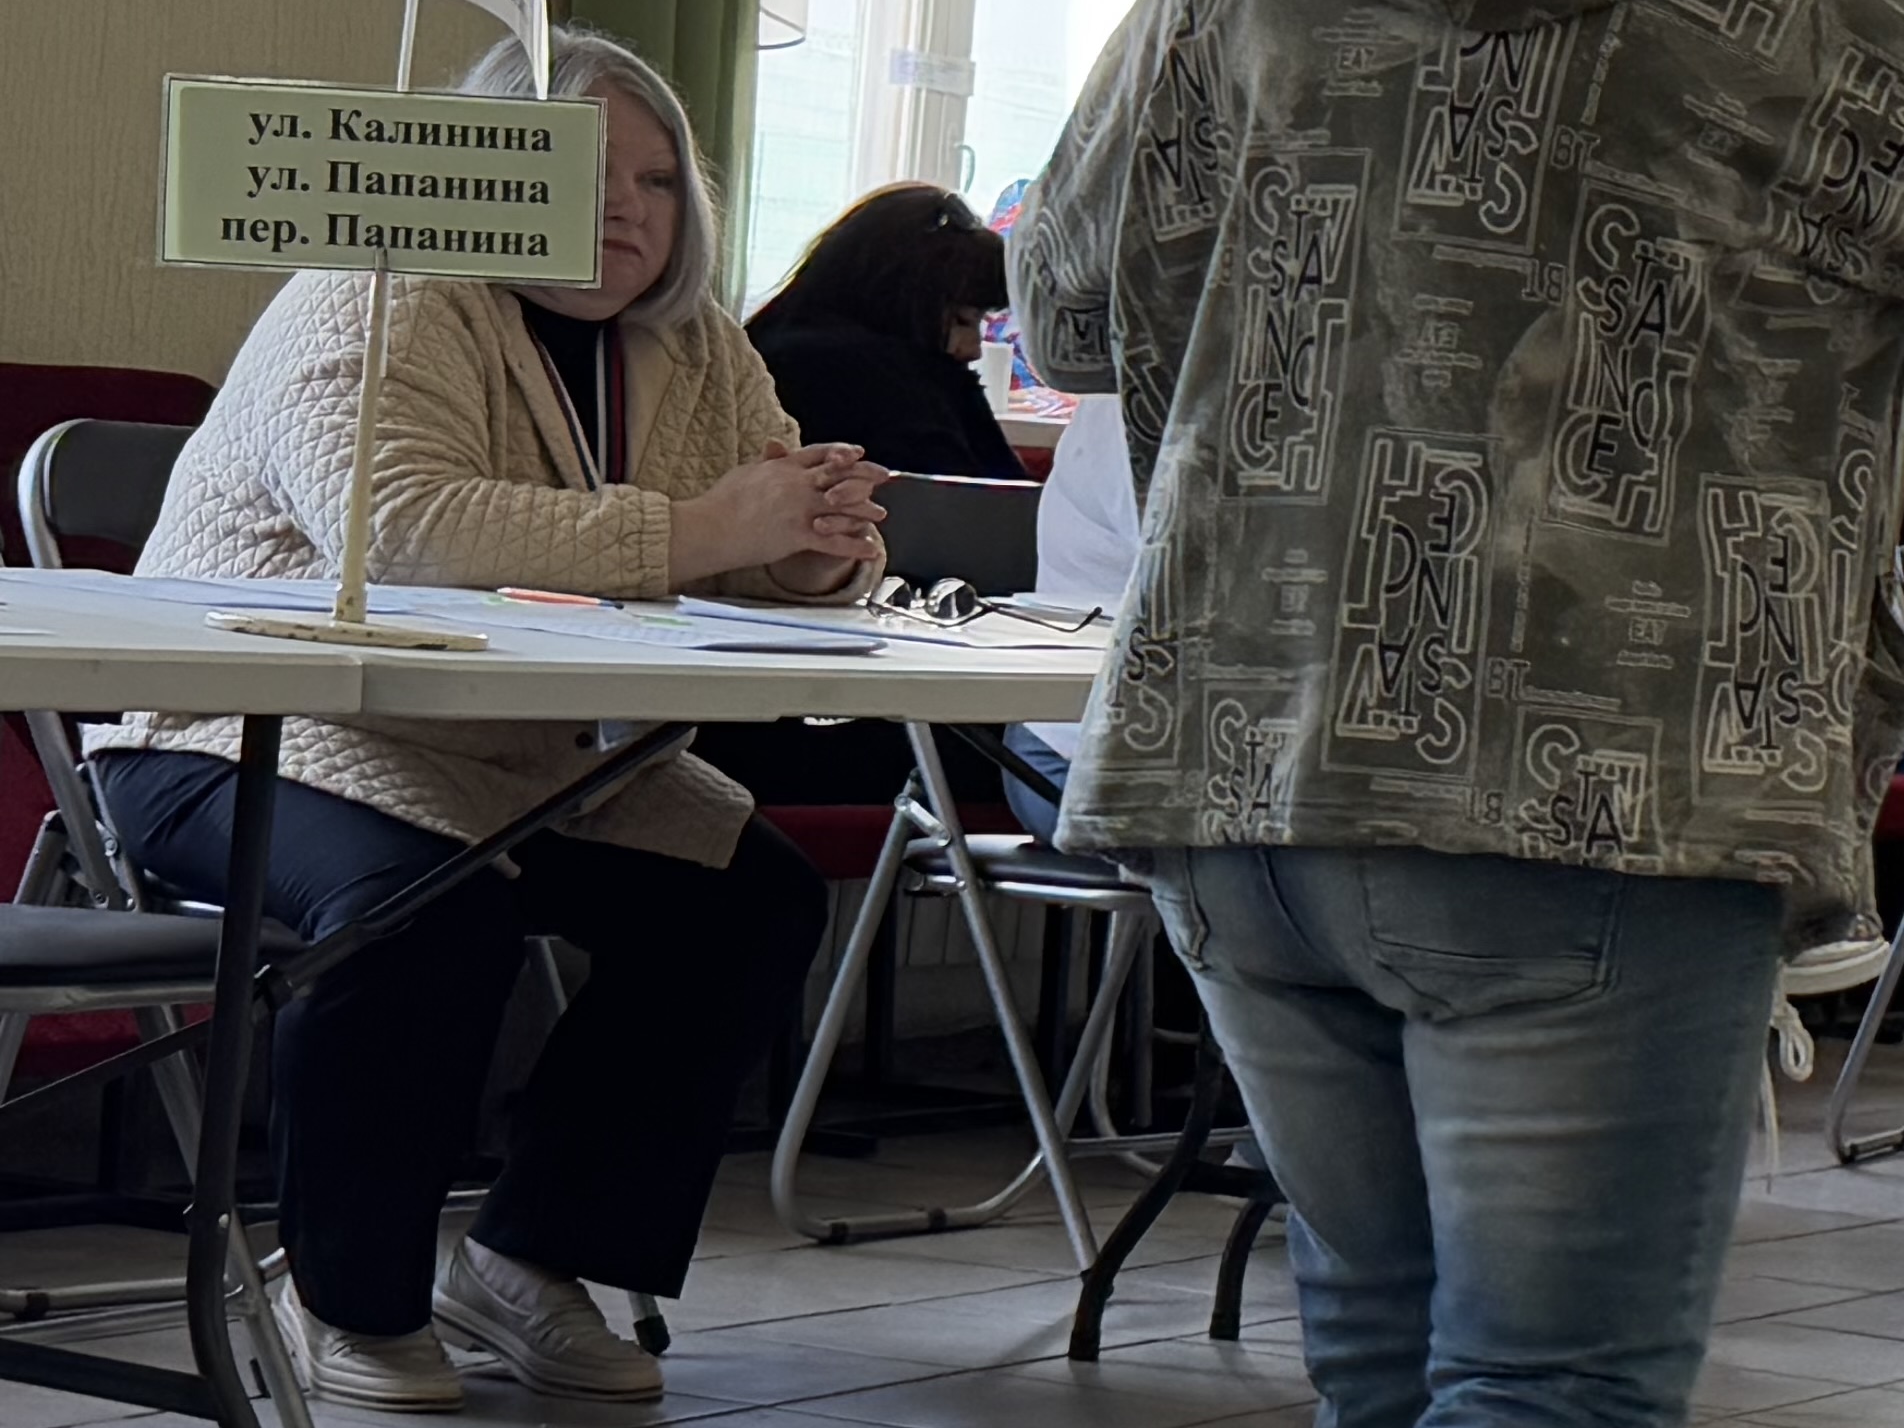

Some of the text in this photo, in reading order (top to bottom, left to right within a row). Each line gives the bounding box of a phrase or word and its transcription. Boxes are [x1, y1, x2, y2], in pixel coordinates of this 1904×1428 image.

[248, 107, 553, 153] ул. Калинина
[247, 160, 551, 205] ул. Папанина
[221, 213, 550, 257] пер. Папанина
